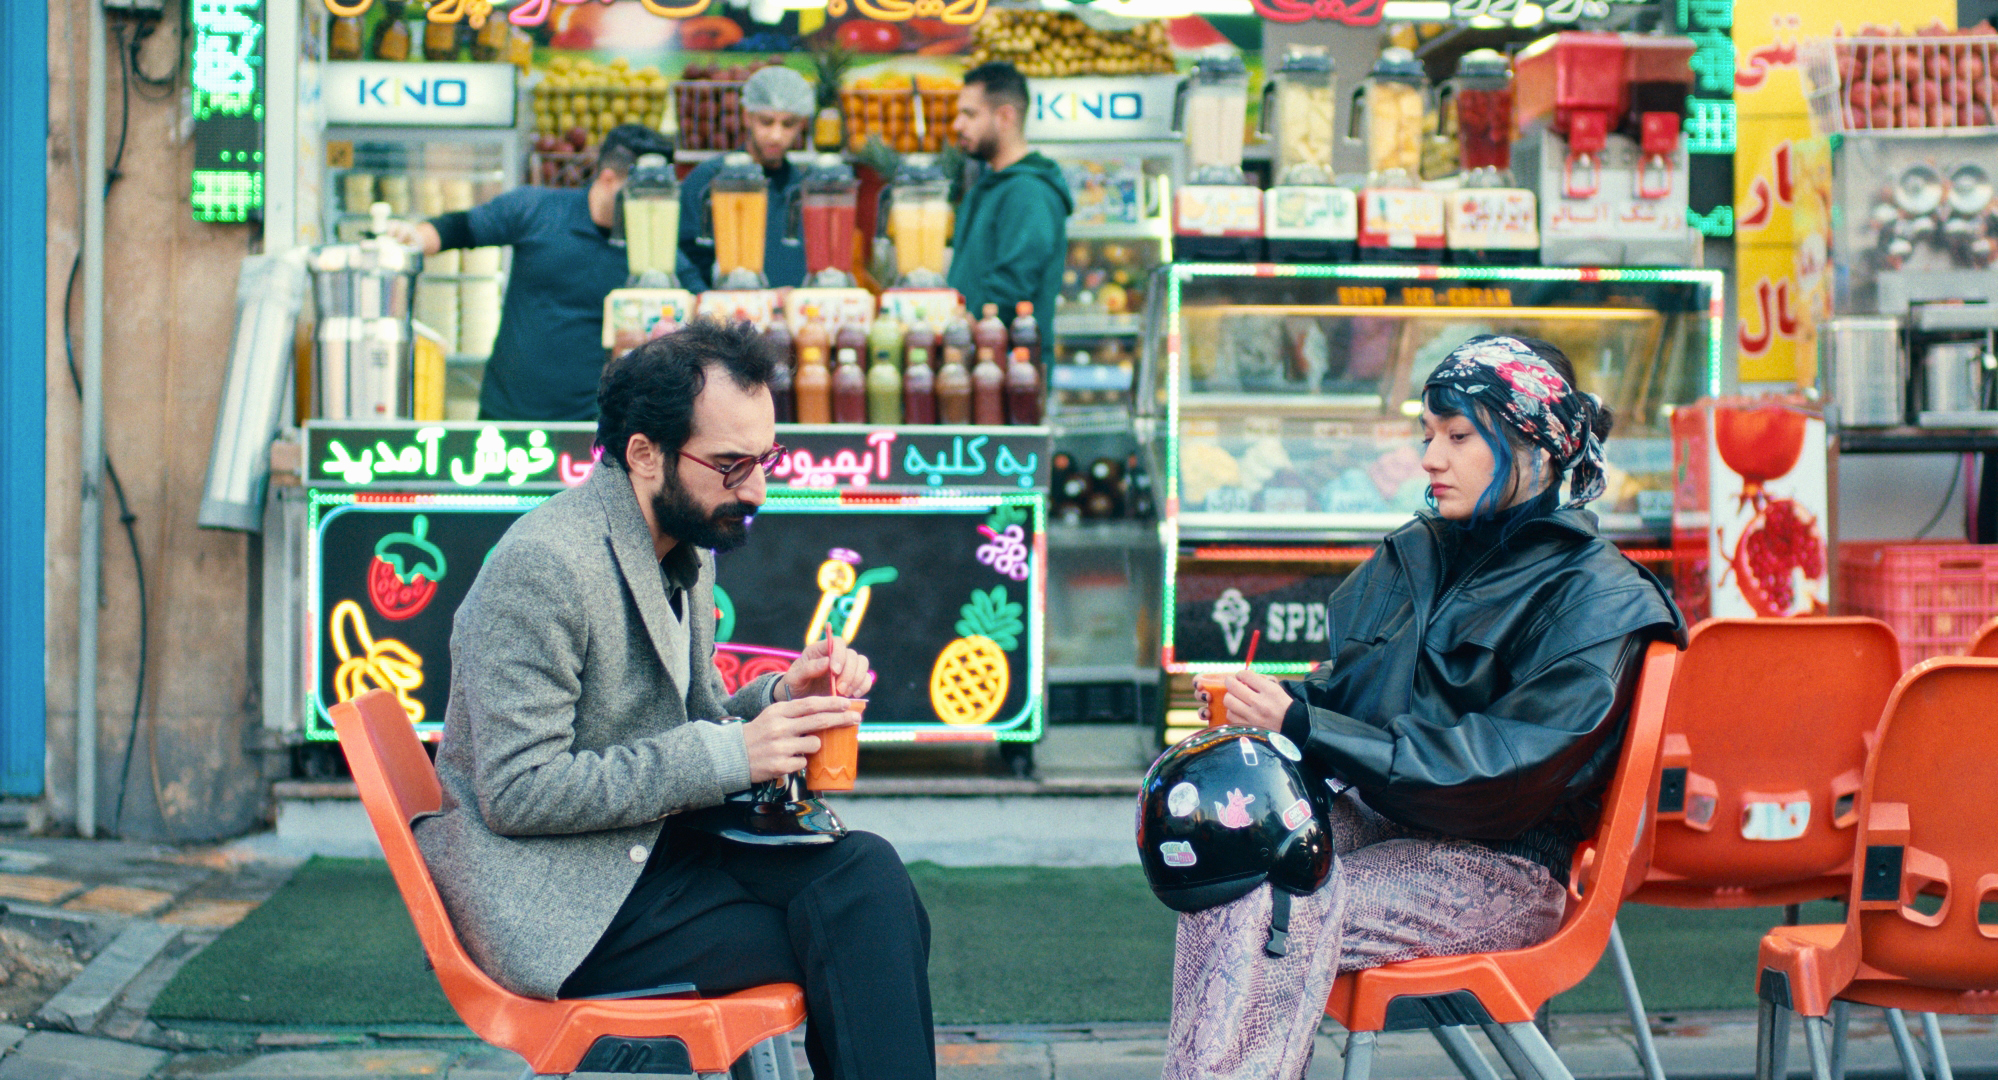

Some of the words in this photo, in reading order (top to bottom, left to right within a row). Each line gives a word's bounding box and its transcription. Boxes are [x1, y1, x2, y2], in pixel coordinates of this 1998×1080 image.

[321, 426, 447, 485] آمدید
[450, 425, 555, 487] خوش
[903, 435, 989, 488] کلبه
[995, 441, 1038, 488] به
[1267, 602, 1331, 643] SPE
